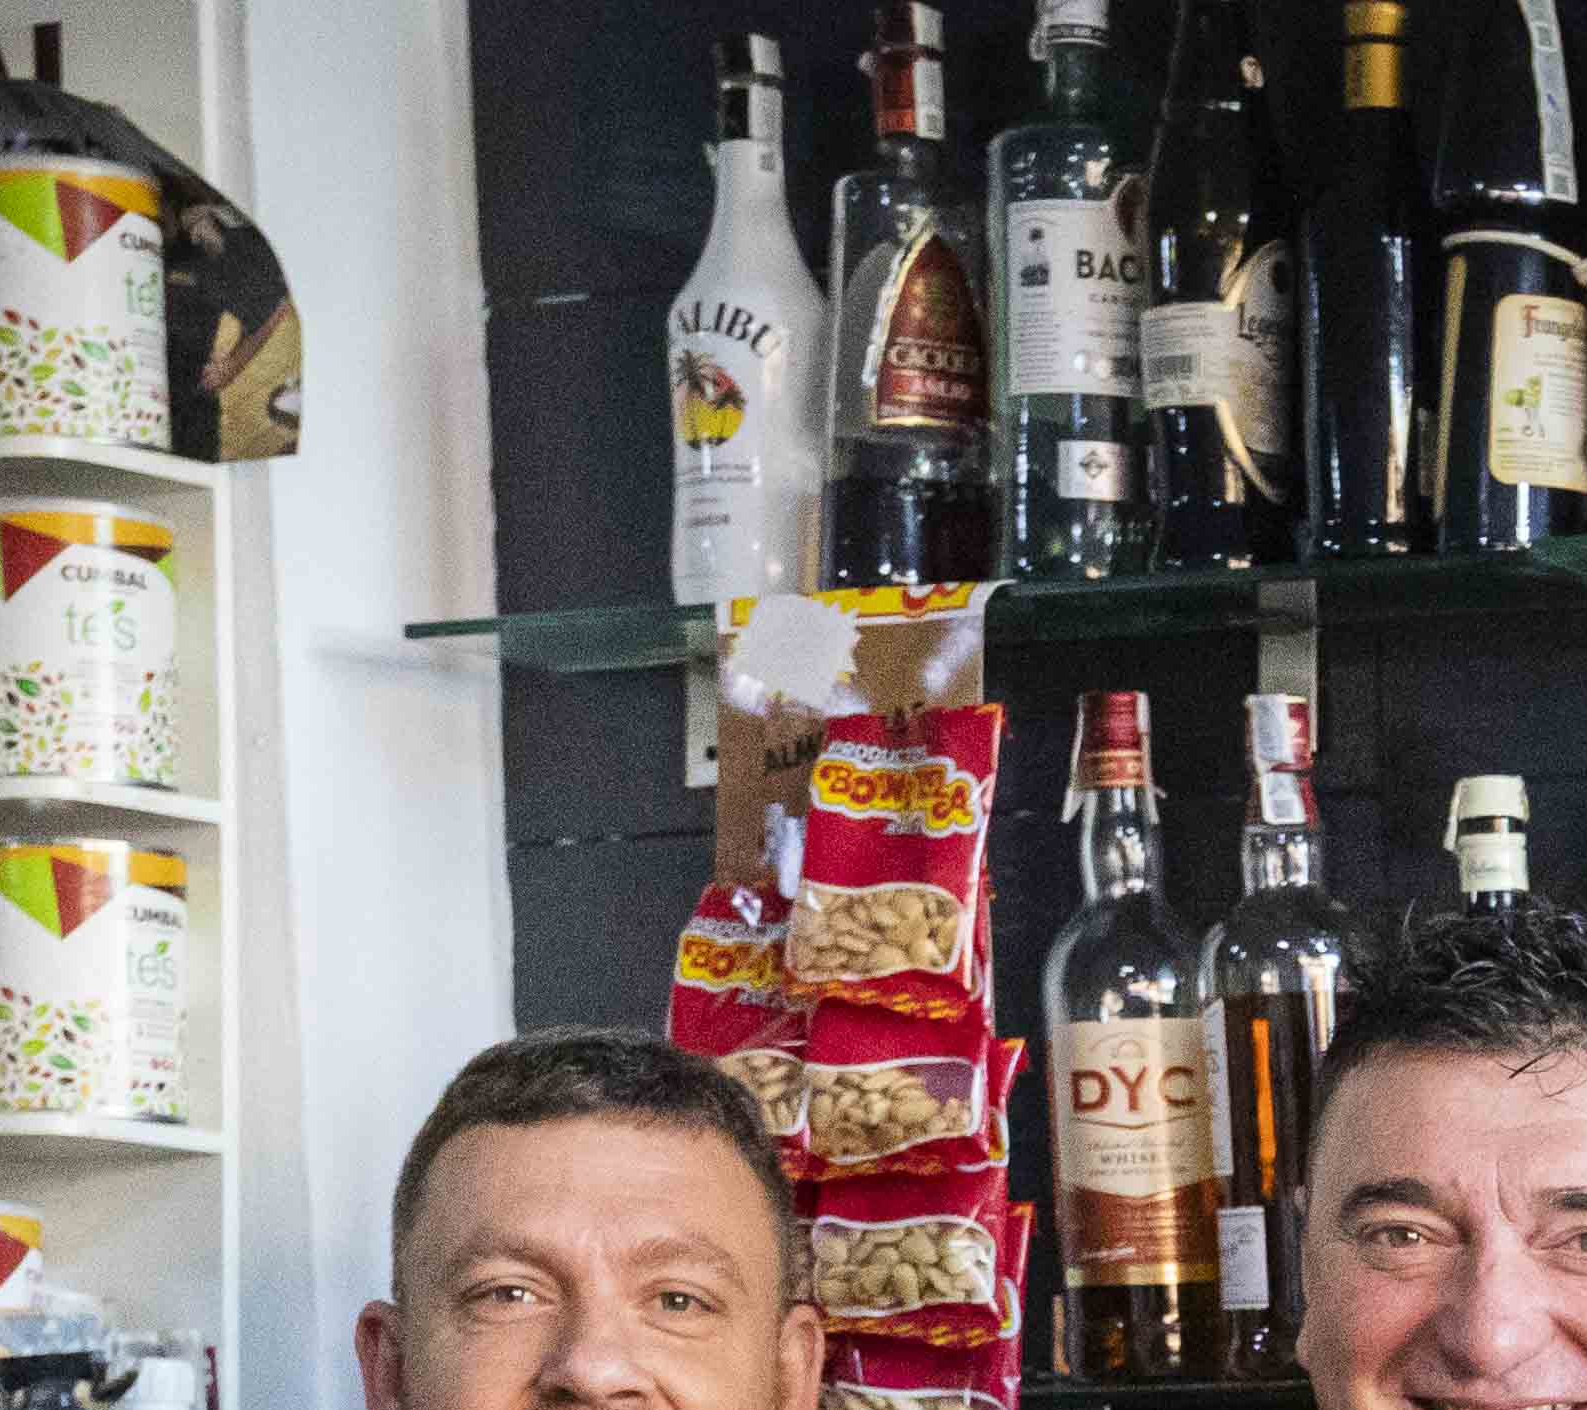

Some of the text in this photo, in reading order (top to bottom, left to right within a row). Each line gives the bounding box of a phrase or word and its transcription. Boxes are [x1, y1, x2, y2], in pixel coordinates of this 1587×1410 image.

[1076, 249, 1143, 286] BAC
[675, 297, 784, 360] ALIBU
[1071, 1065, 1197, 1115] DYC
